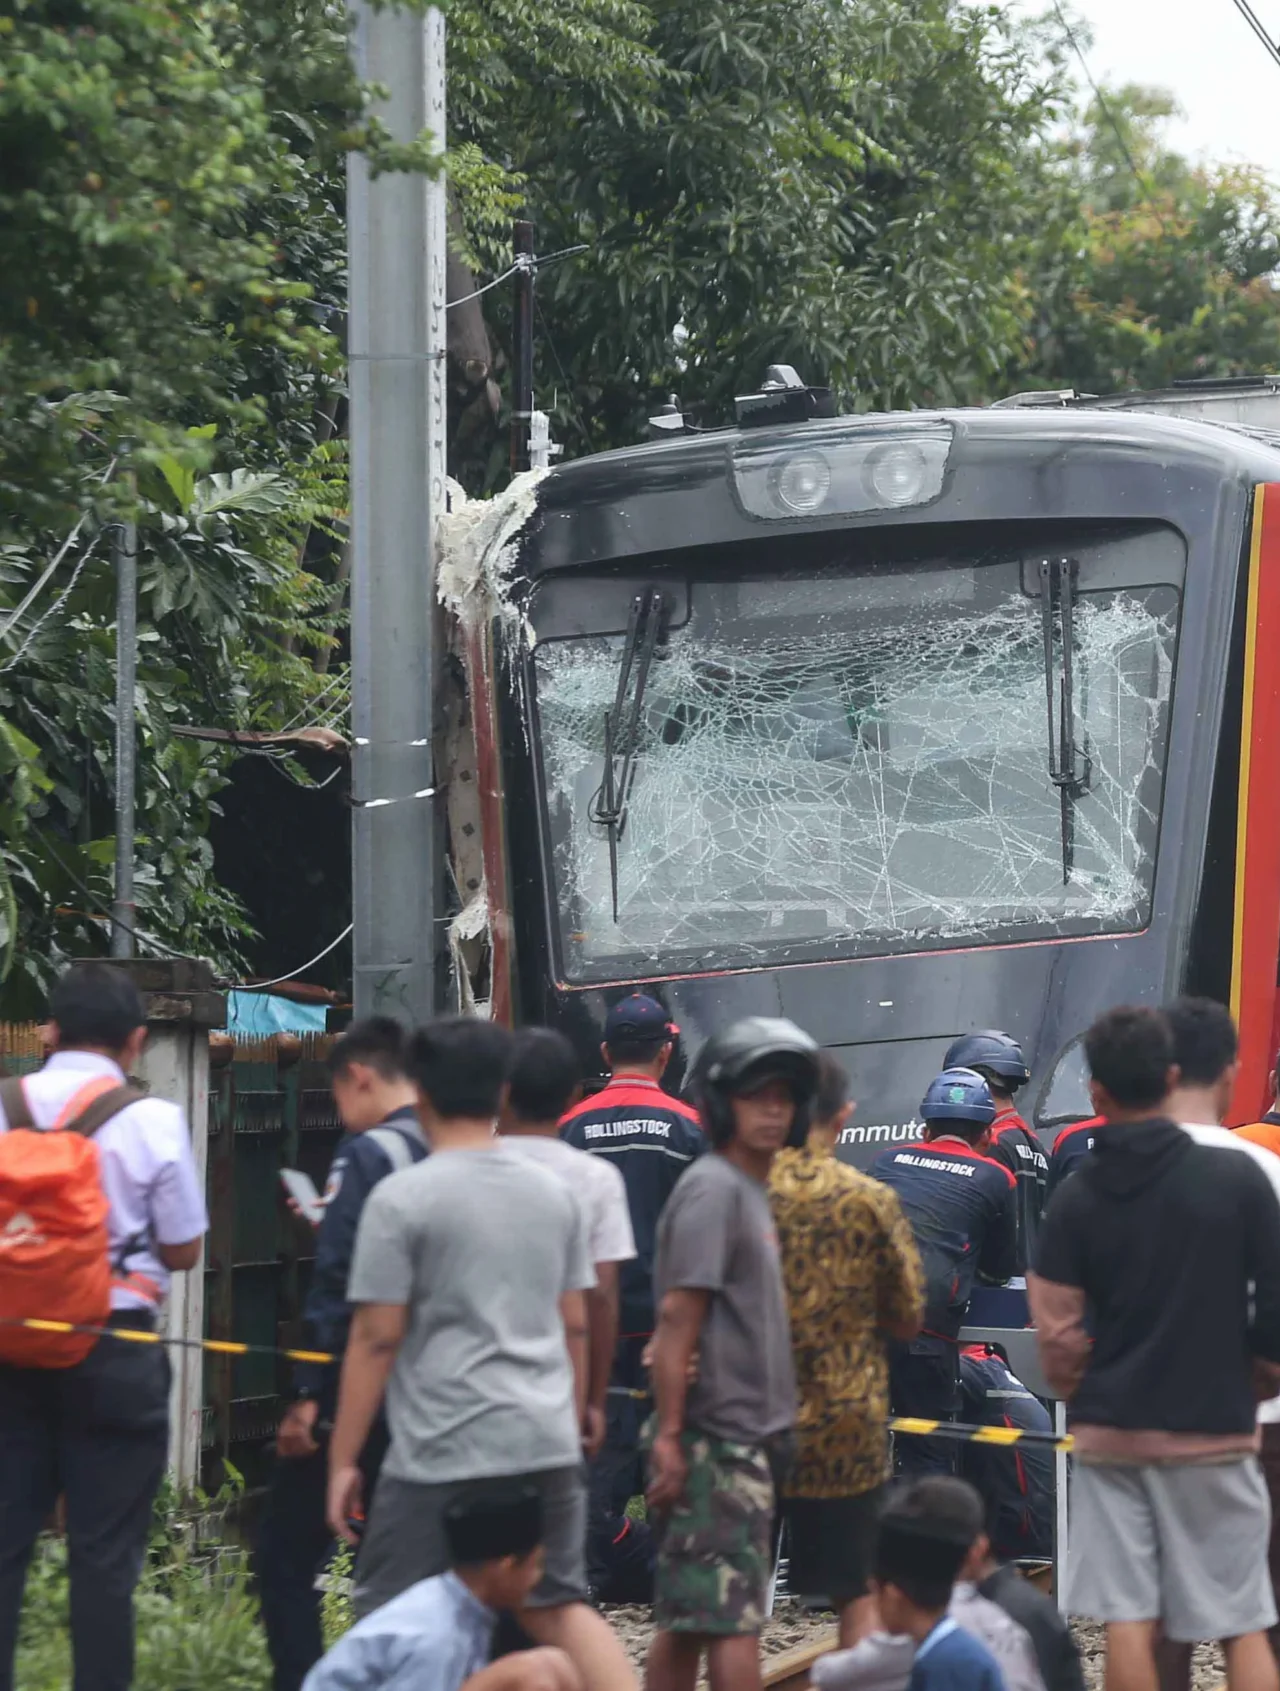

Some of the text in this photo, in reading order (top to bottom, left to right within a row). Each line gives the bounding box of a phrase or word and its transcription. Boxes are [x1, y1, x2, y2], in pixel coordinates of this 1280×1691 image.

[584, 1119, 672, 1140] ROLLINGSTOCK
[834, 1118, 926, 1145] mmute
[894, 1153, 977, 1177] ROLLINGSTOCK
